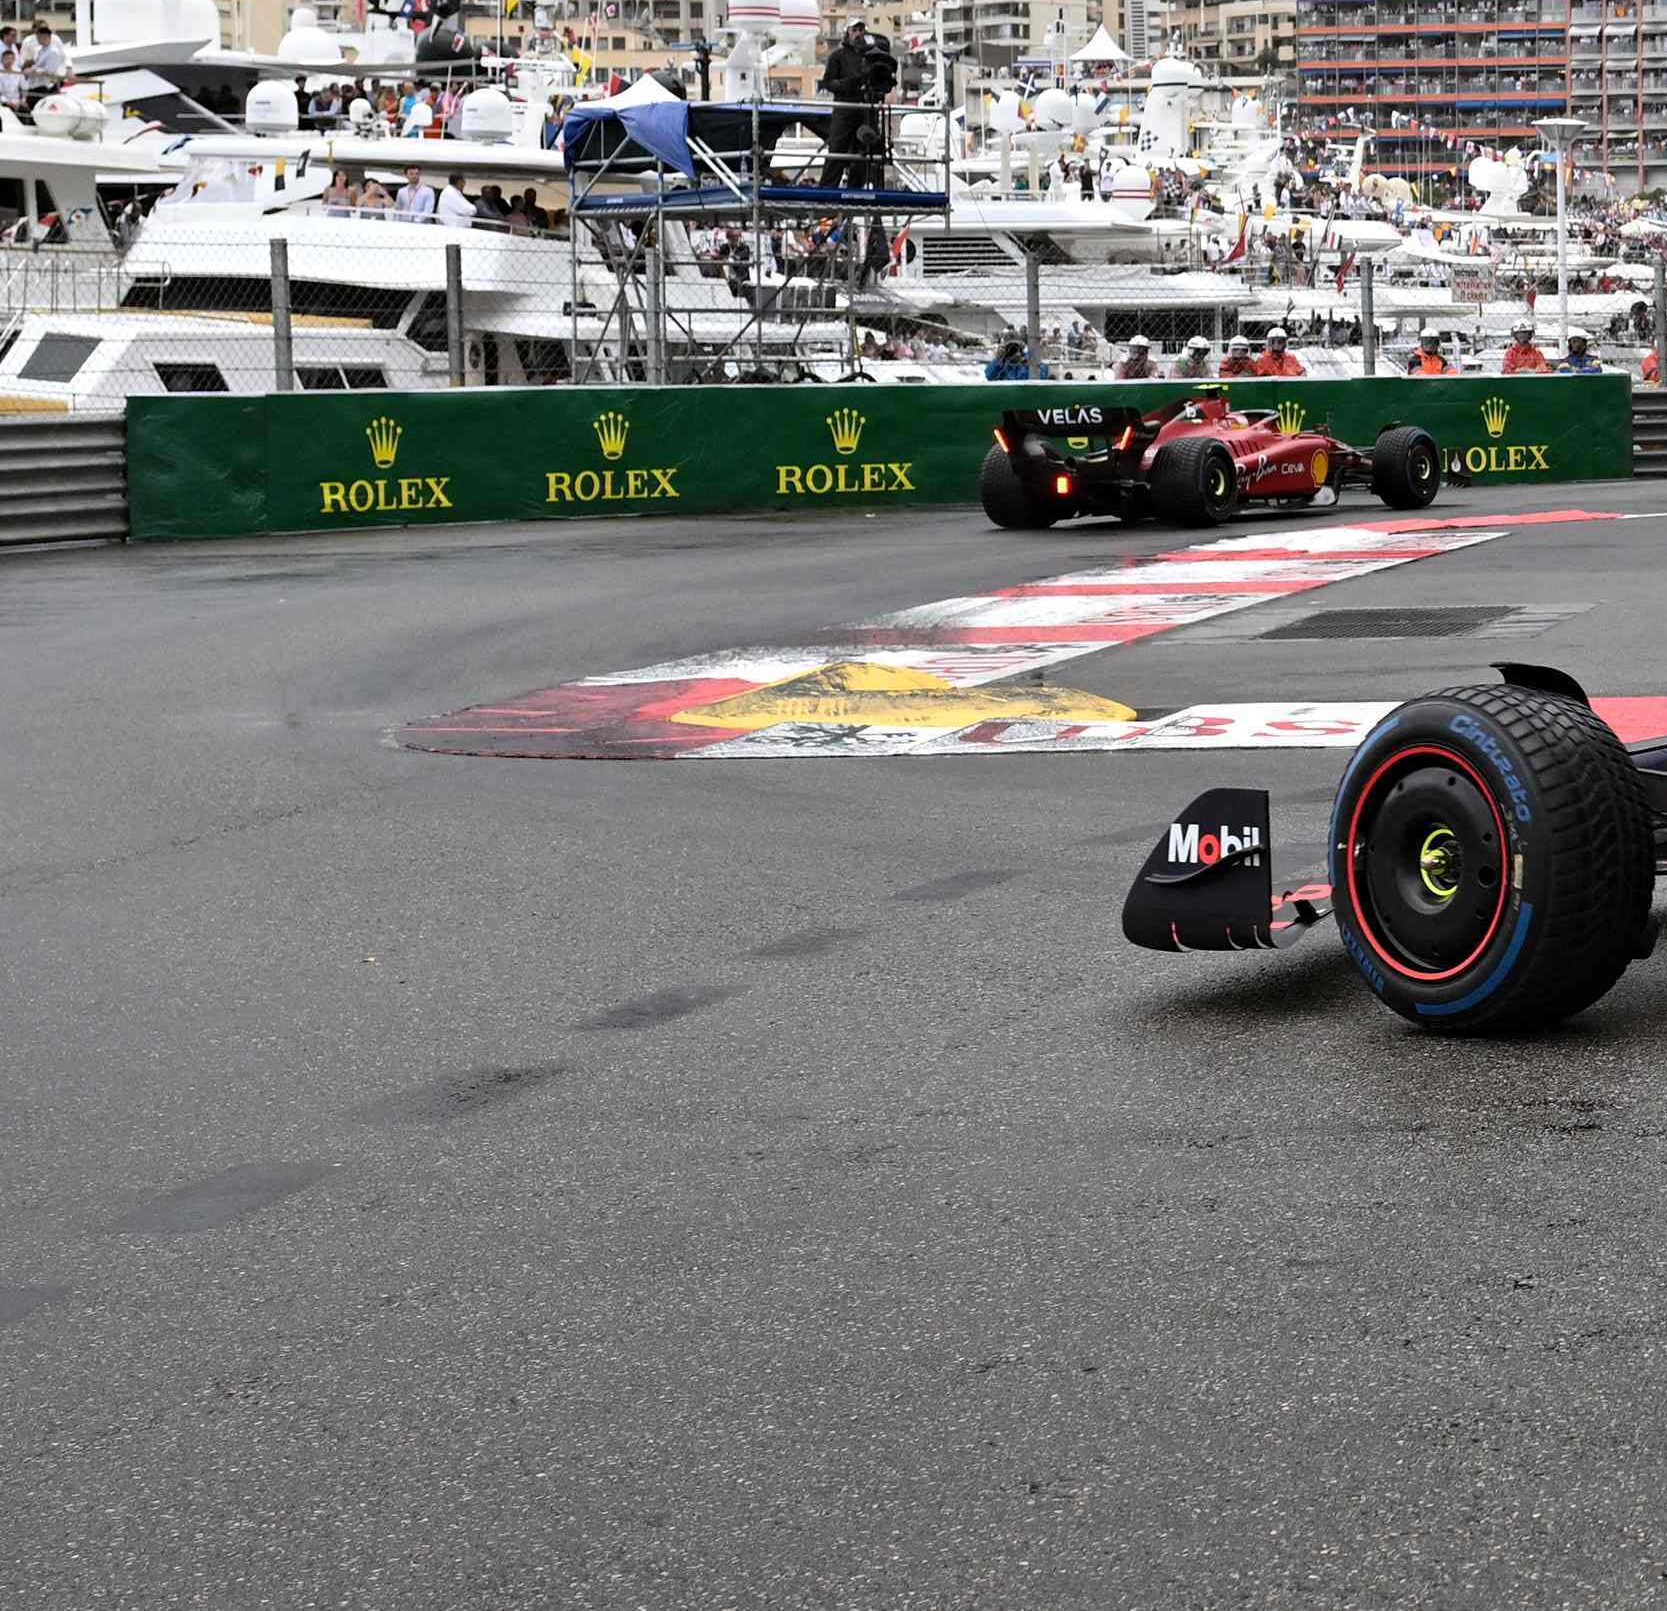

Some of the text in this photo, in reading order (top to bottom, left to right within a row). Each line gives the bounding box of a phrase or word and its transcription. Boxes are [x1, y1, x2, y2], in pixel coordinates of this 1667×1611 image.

[320, 476, 453, 513] ROLEX
[546, 468, 680, 502] ROLEX
[776, 464, 912, 495] ROLEX
[1451, 714, 1532, 822] Cinturato
[1167, 822, 1261, 867] Mobil
